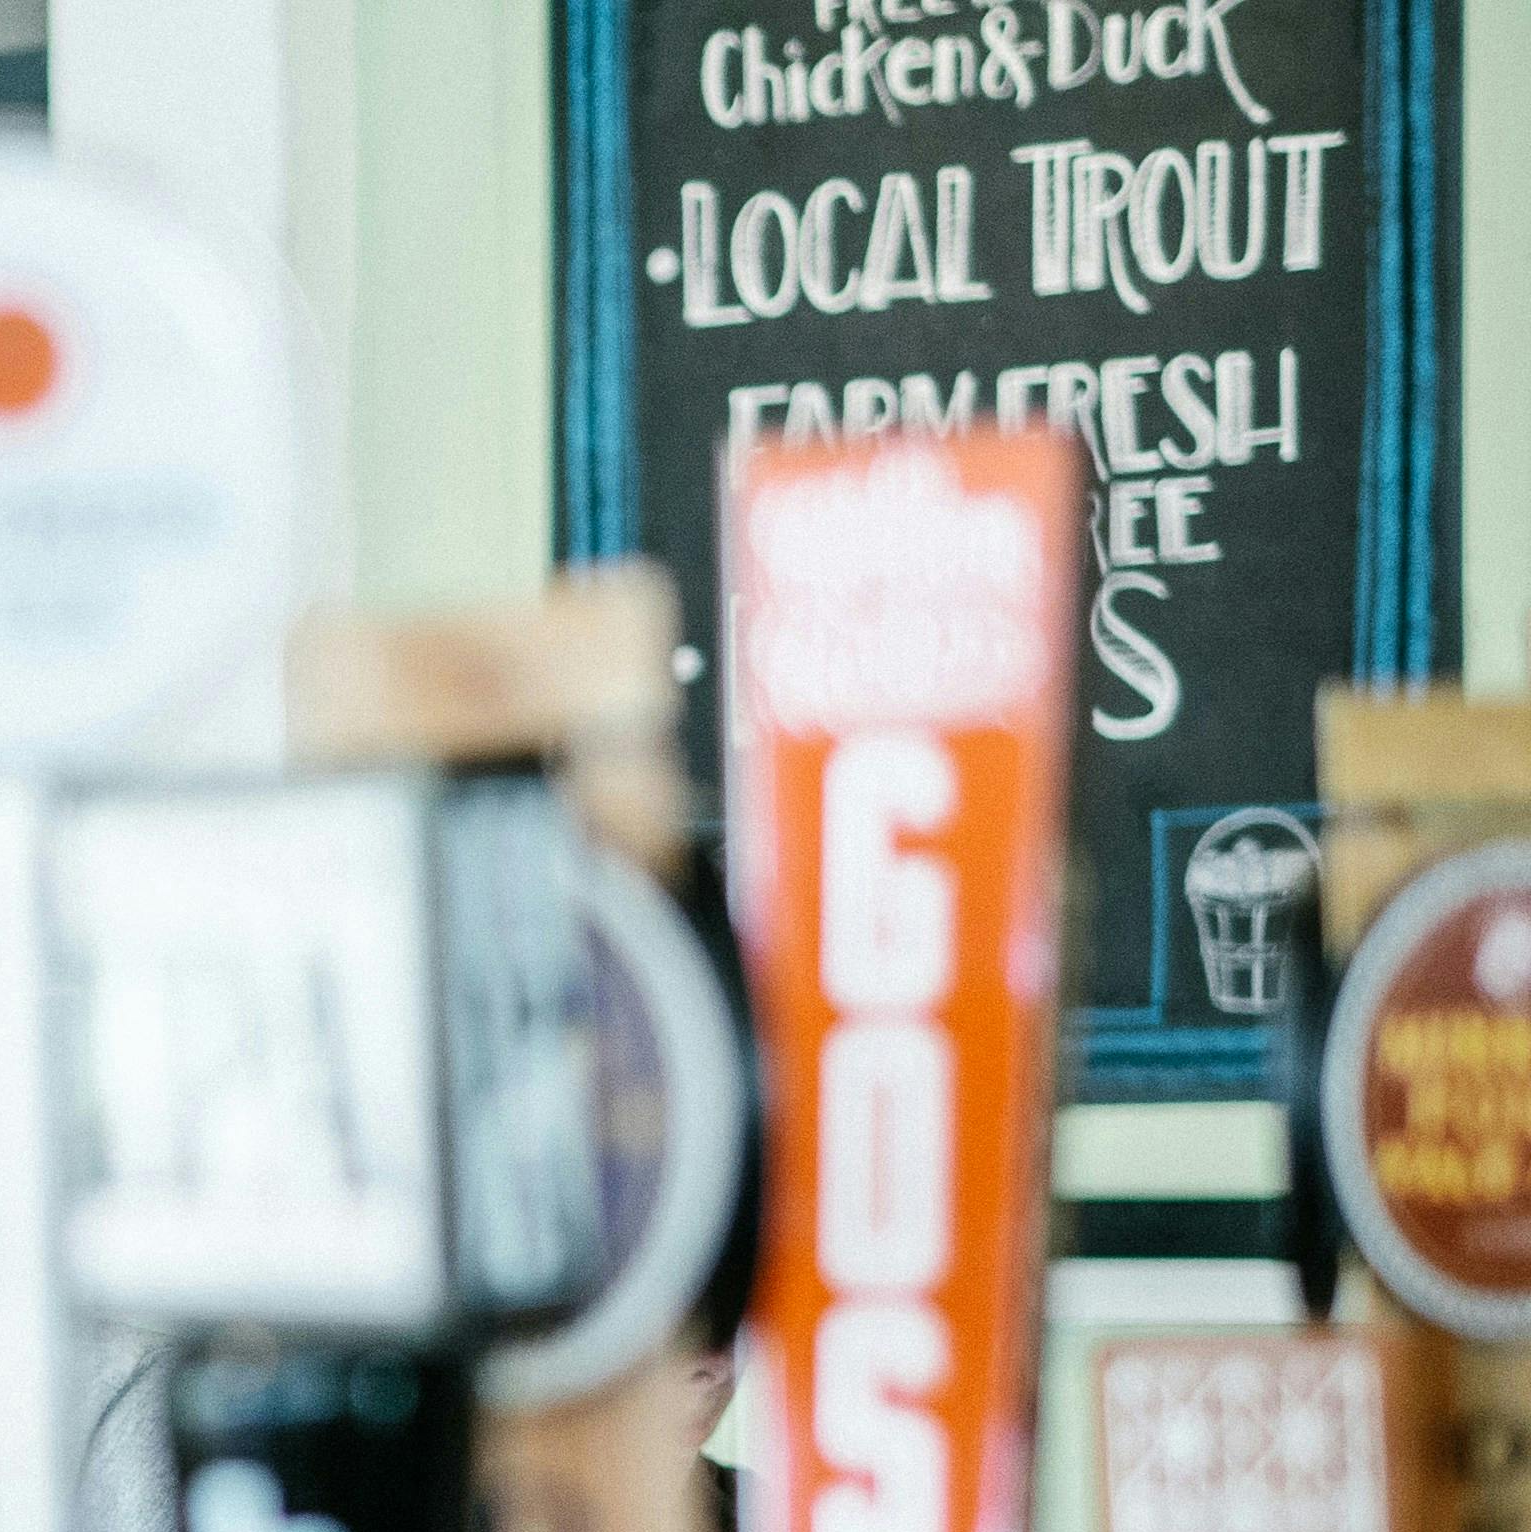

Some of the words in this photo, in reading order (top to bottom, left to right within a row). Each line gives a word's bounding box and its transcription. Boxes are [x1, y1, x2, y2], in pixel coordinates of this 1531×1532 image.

[682, 165, 992, 328] LOCAL
[1010, 132, 1345, 314] TROUT
[995, 346, 1299, 482] FRESH
